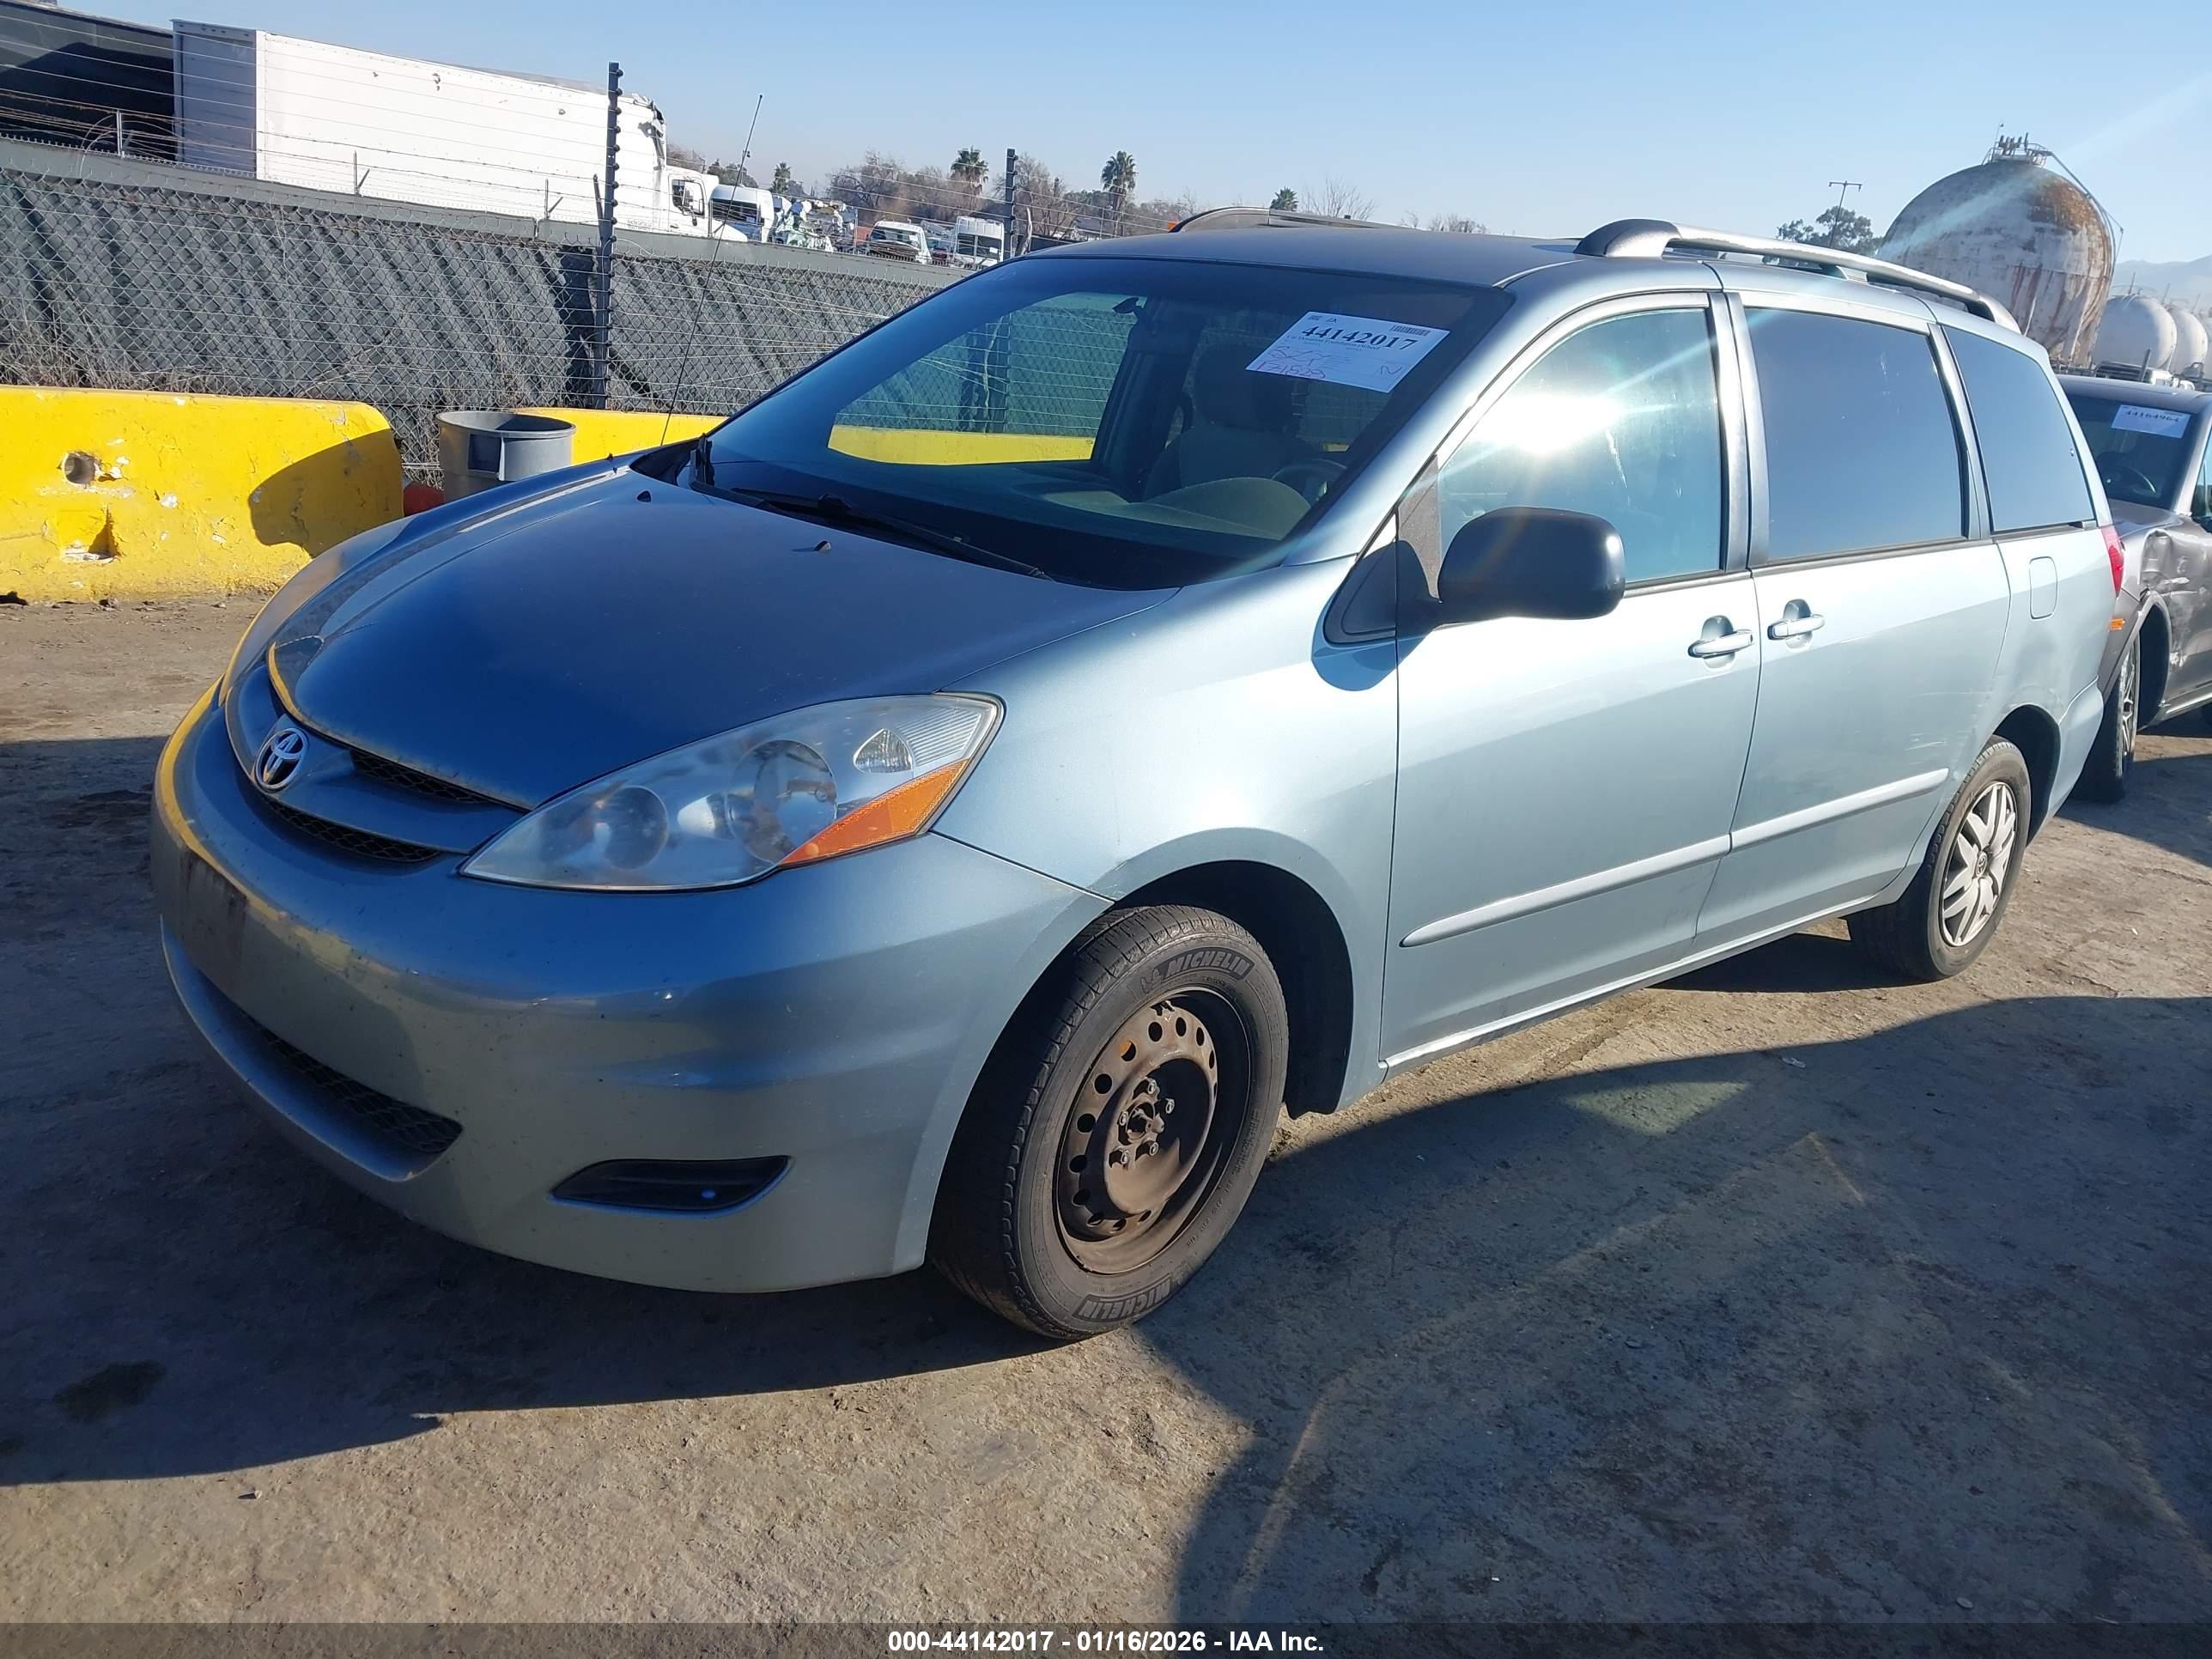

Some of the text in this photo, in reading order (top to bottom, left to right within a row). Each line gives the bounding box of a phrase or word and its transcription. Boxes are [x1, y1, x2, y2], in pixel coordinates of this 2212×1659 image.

[1302, 325, 1419, 350] 44142017
[1165, 950, 1251, 976] MICHELIN
[1078, 1278, 1170, 1321] MICHELIN
